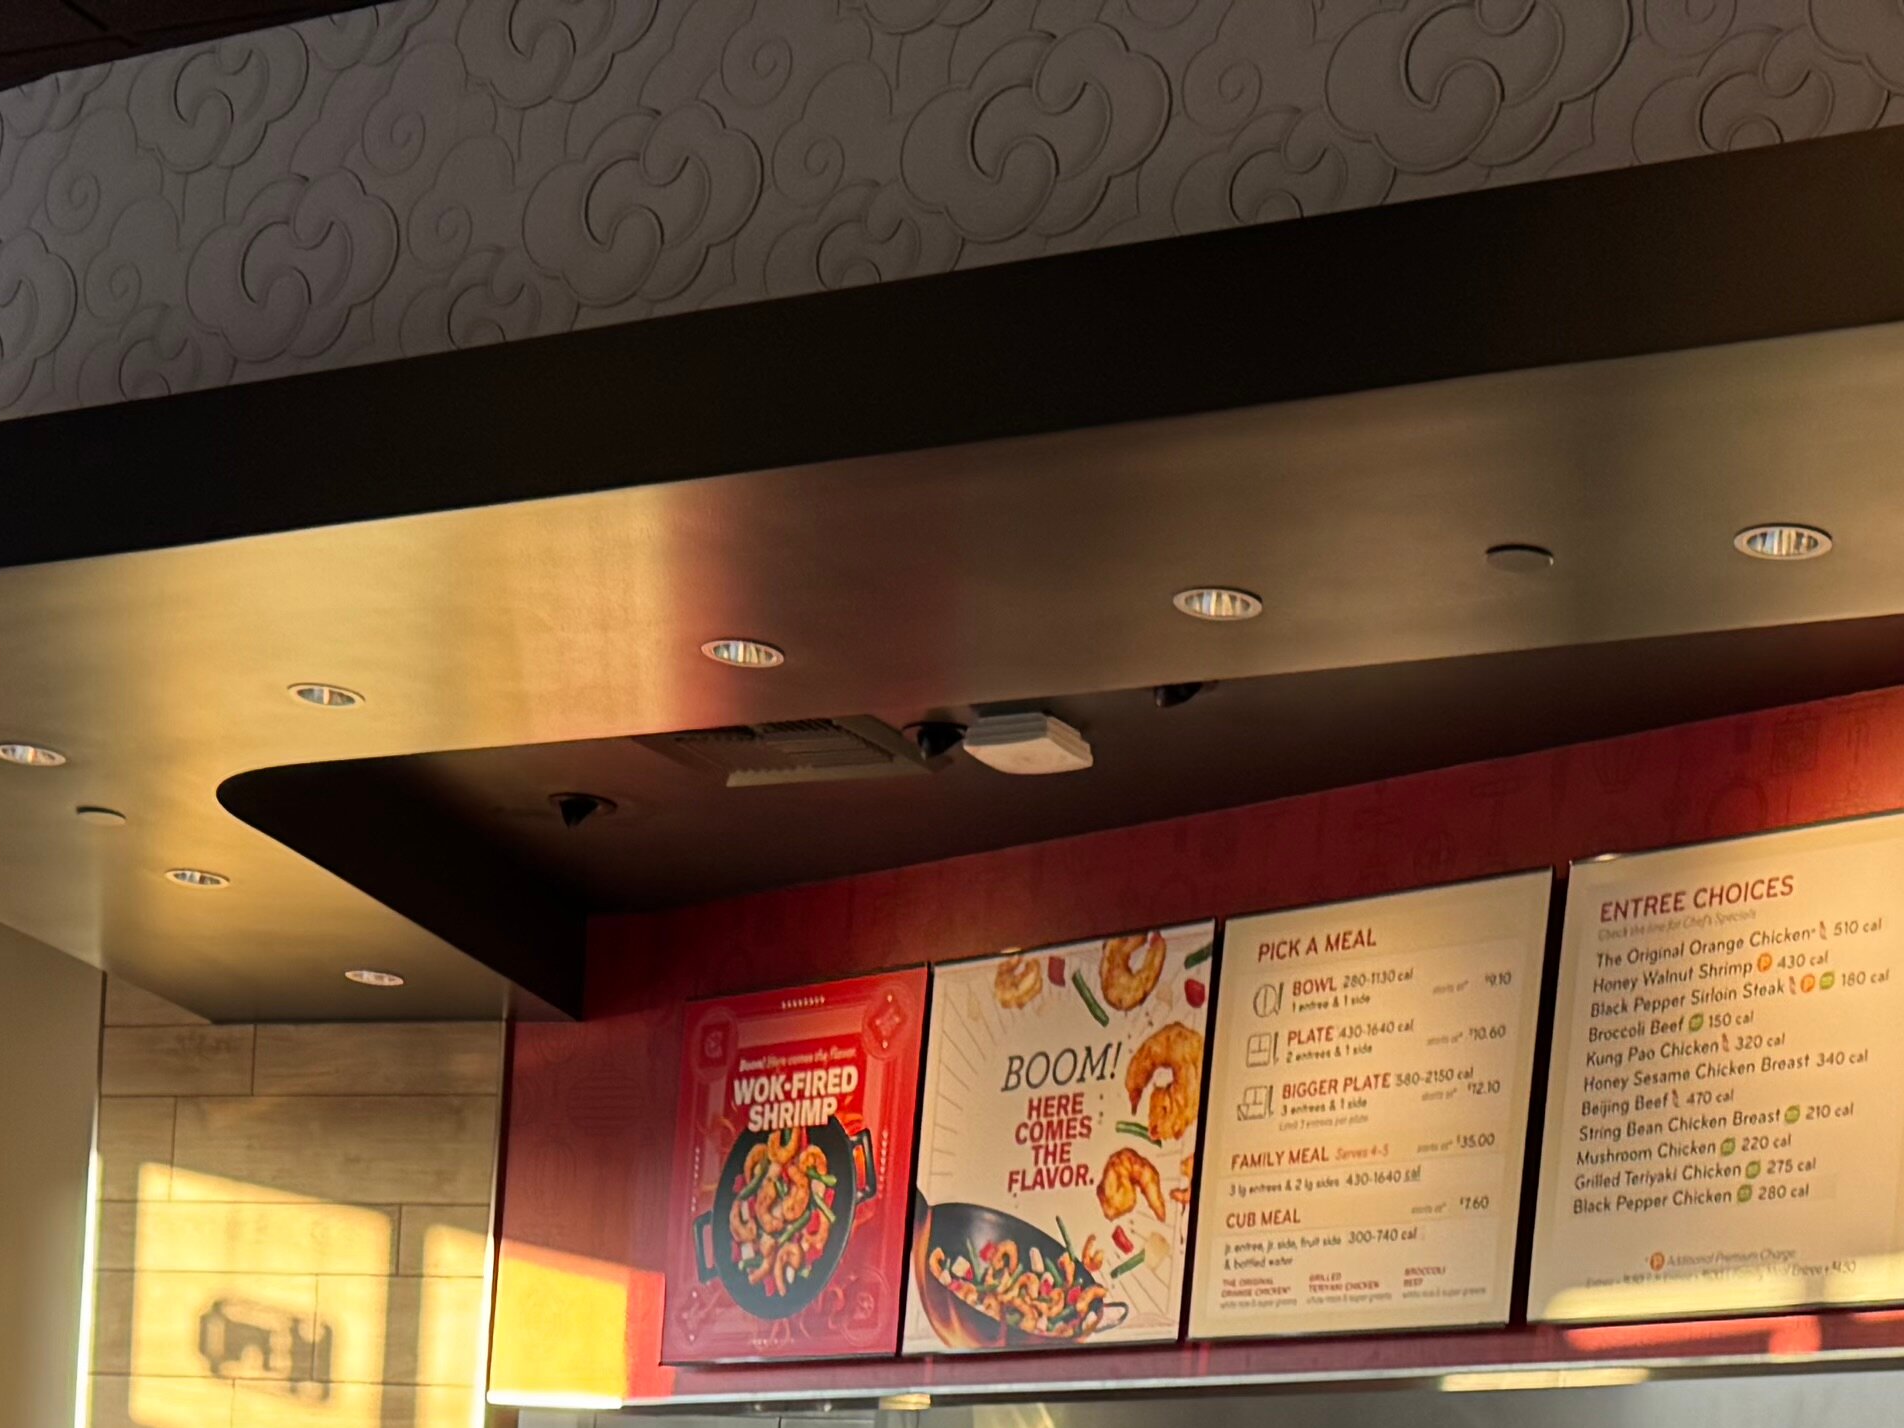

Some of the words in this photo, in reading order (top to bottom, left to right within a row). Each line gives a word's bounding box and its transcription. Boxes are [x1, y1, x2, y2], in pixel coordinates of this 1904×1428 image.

[1600, 891, 1686, 924] ENTREE
[1692, 875, 1794, 910] CHOICES
[1257, 938, 1301, 963] PICK
[1305, 936, 1318, 956] A
[1324, 927, 1377, 953] MEAL
[1596, 952, 1623, 969] The
[1626, 942, 1685, 966] Original
[1688, 938, 1745, 957] Orange
[1292, 976, 1337, 997] BOWL
[1592, 977, 1639, 994] Honey
[1642, 966, 1694, 987] Walnut
[1698, 962, 1753, 980] Shrimp
[1287, 1025, 1335, 1047] PLATE
[1588, 1021, 1646, 1044] Broccoli
[1650, 1016, 1685, 1036] Beef
[1001, 1041, 1122, 1092] BOOM!
[1585, 1051, 1623, 1068] Kung
[1627, 1045, 1656, 1063] Pao
[1659, 1039, 1719, 1059] Chicken
[1281, 1078, 1339, 1100] BIGGER
[1342, 1071, 1392, 1093] PLATE
[748, 1097, 838, 1132] SHRIMP
[1027, 1092, 1085, 1121] HERE
[1015, 1115, 1092, 1145] COMES
[1032, 1142, 1072, 1167] THE
[1231, 1150, 1285, 1171] FAMILY
[1288, 1146, 1329, 1165] MEAL
[1576, 1147, 1653, 1166] Mushroom
[1657, 1139, 1716, 1159] Chicken
[1008, 1163, 1094, 1193] FLAVOR.
[1574, 1171, 1621, 1191] Grilled
[1624, 1167, 1677, 1188] Teriyaki
[1681, 1162, 1742, 1181] Chicken
[1225, 1211, 1257, 1229] CUB
[1260, 1208, 1301, 1226] MEAL
